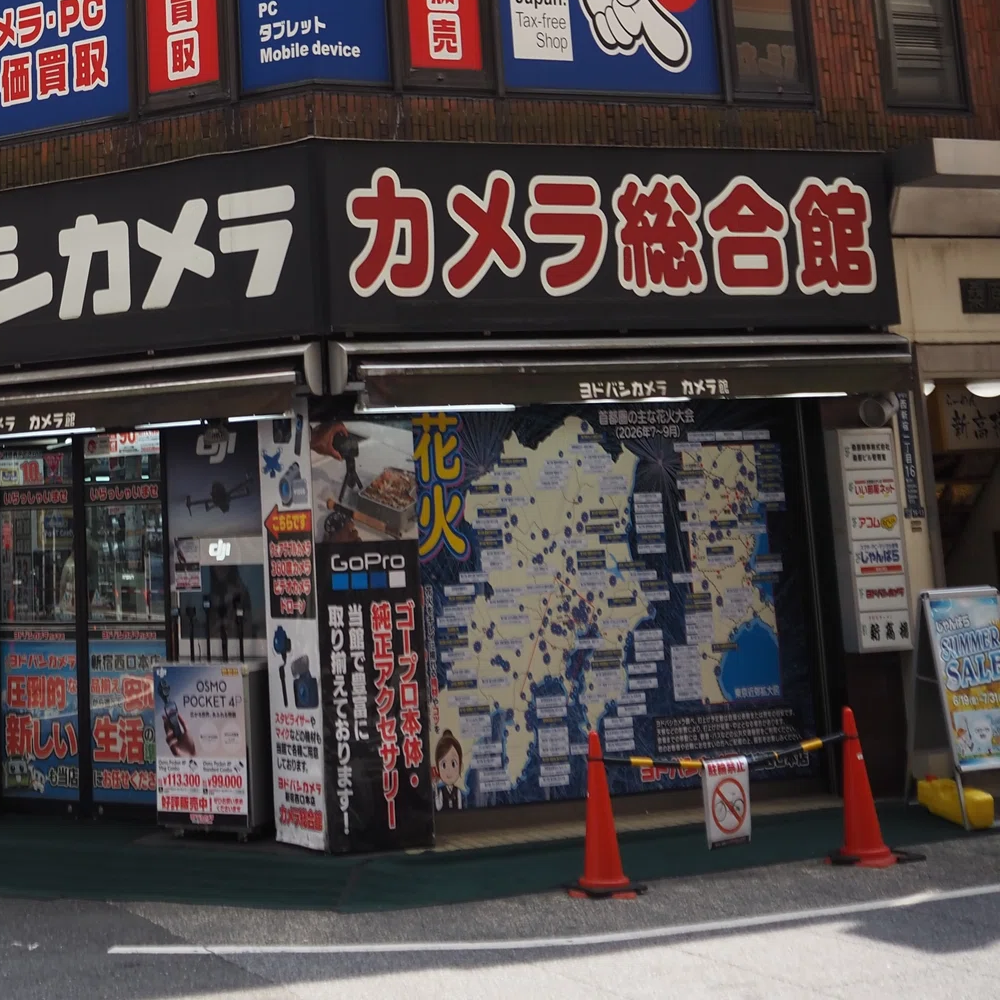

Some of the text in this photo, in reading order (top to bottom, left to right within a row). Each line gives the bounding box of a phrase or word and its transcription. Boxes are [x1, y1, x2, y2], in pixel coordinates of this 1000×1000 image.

[258, 0, 278, 18] PC
[259, 15, 327, 42] タブレット
[516, 11, 567, 30] Tax-free
[536, 32, 568, 52] Shop
[260, 40, 361, 64] Mobile device
[346, 166, 877, 298] カメラ総合館
[579, 378, 730, 399] ヨドバシカメラ カメラ館
[27, 411, 76, 429] カメラ館
[599, 408, 695, 426] 首都圏の主な花火大会
[903, 465, 917, 478] 16
[90, 484, 159, 501] いらっしゃいませ
[412, 411, 470, 562] 花火
[855, 484, 895, 496] いい部屋ネット
[3, 489, 68, 505] いらっしゃいませ
[272, 512, 307, 531] こちらです
[858, 517, 881, 529] アコム
[271, 559, 311, 577] 360度カメラ
[331, 552, 405, 572] GoPro
[273, 577, 311, 595] ビデオカメラ
[279, 597, 306, 615] ドローン
[940, 626, 1000, 661] SUMMER
[347, 603, 370, 742] 当館で豊富に
[945, 650, 1000, 691] SALE
[196, 680, 227, 693] OSMO
[183, 695, 225, 709] POCKET
[371, 600, 400, 830] 純正アクセサリー
[5, 713, 78, 760] 新しい
[707, 761, 746, 777] 駐輪禁止
[278, 777, 321, 795] ヨドバシカメラ
